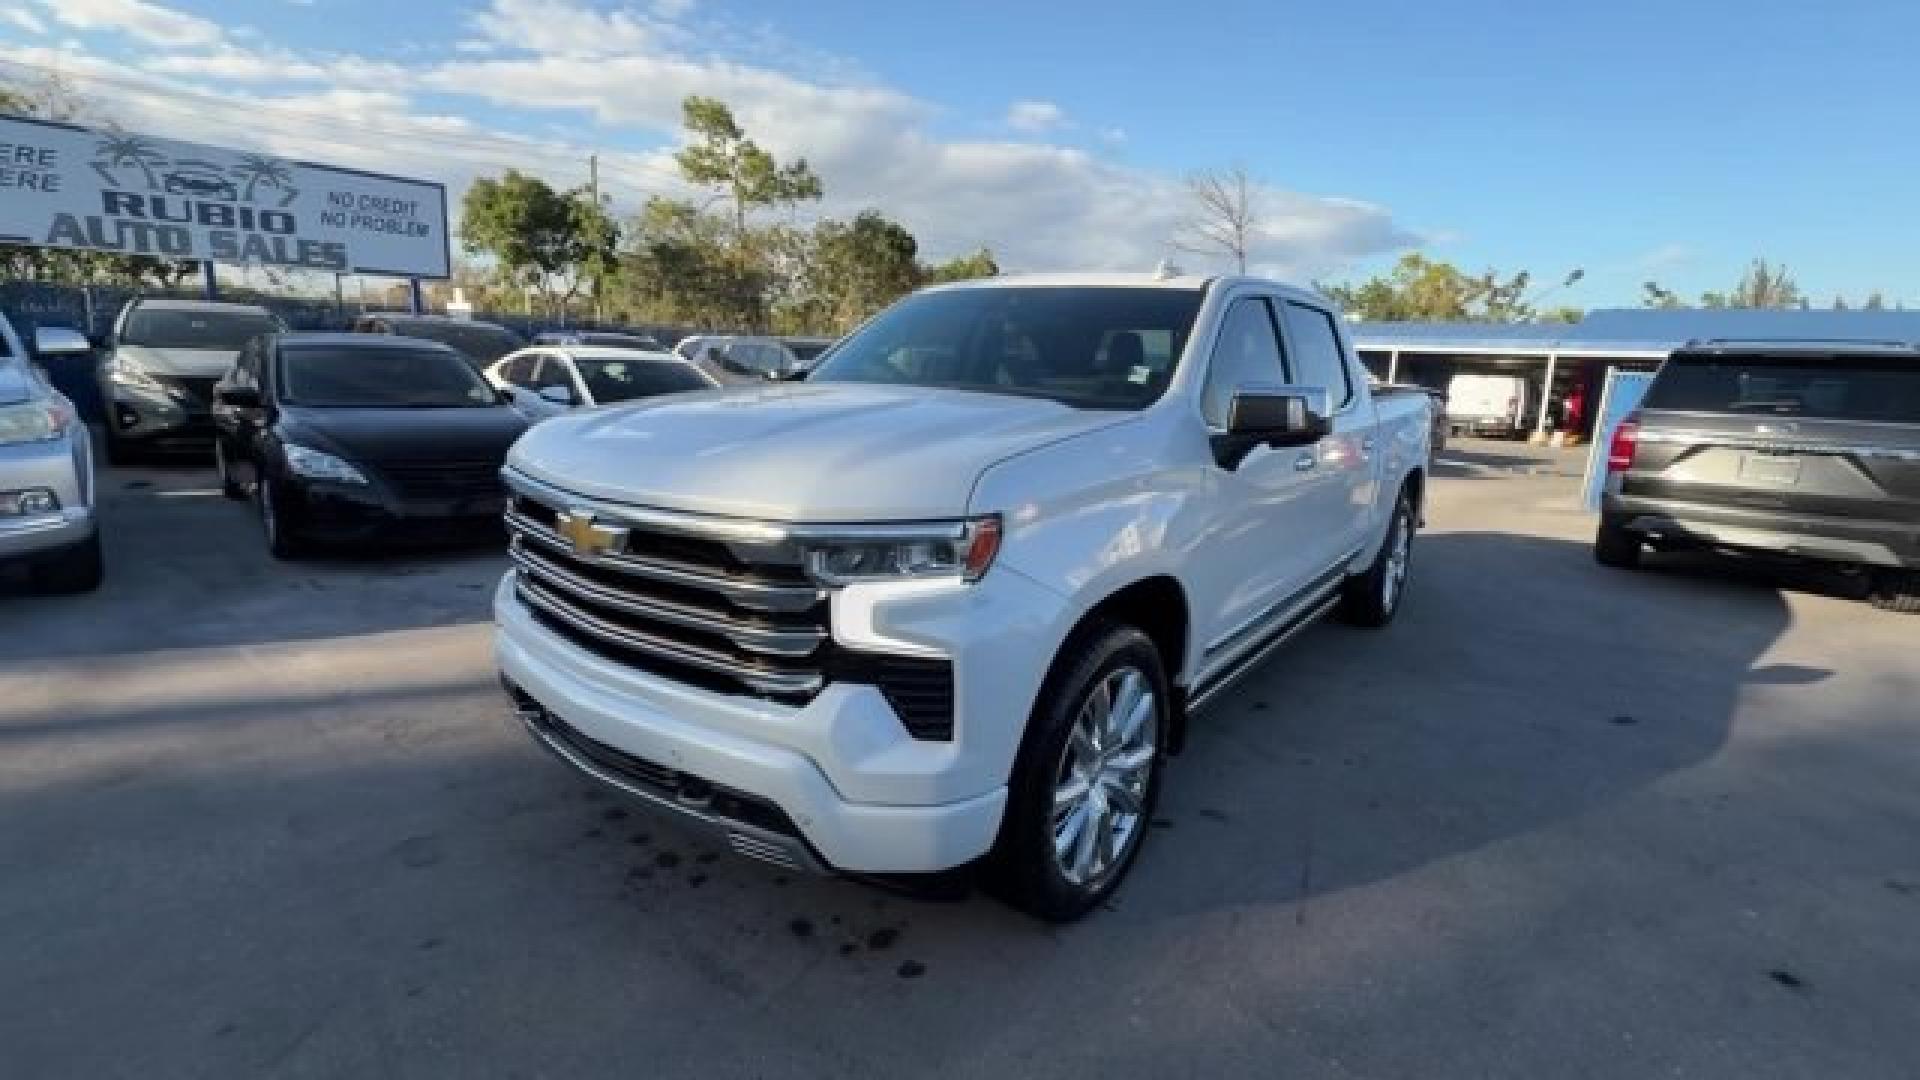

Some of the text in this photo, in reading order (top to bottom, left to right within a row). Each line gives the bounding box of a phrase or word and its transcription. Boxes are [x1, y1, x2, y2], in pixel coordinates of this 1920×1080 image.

[101, 191, 297, 235] RUBIO
[328, 191, 418, 217] NO CREDIT
[47, 213, 348, 270] AUTO SALES
[320, 210, 430, 238] NO PROBLEM
